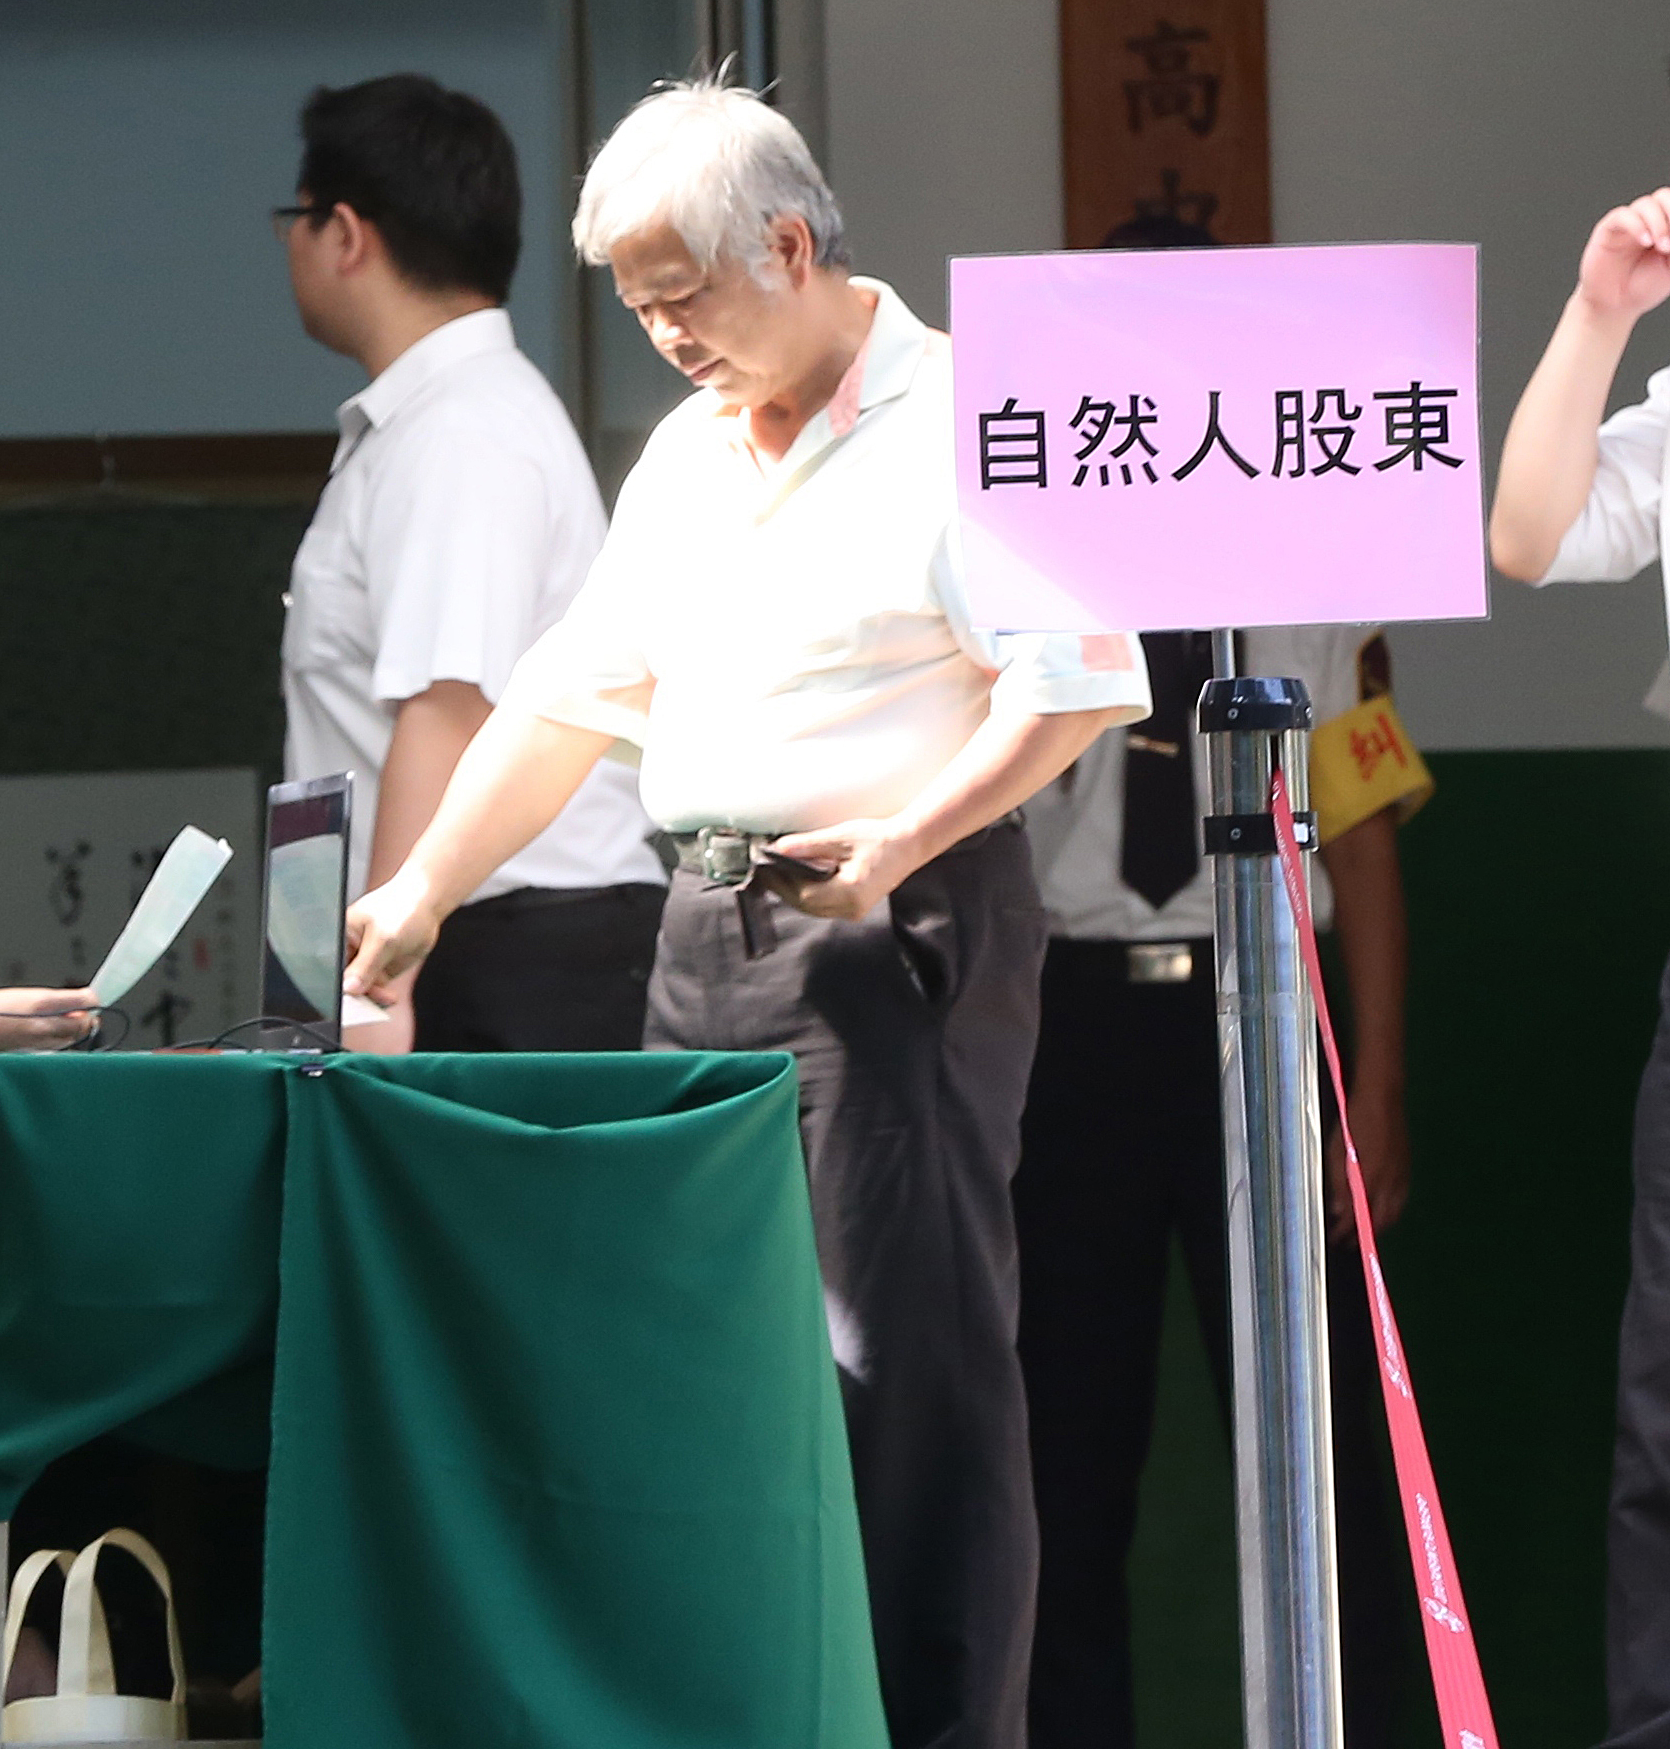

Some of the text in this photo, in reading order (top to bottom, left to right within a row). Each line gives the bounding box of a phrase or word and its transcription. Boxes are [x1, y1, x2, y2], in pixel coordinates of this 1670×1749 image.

[976, 381, 1465, 490] 自然人股東
